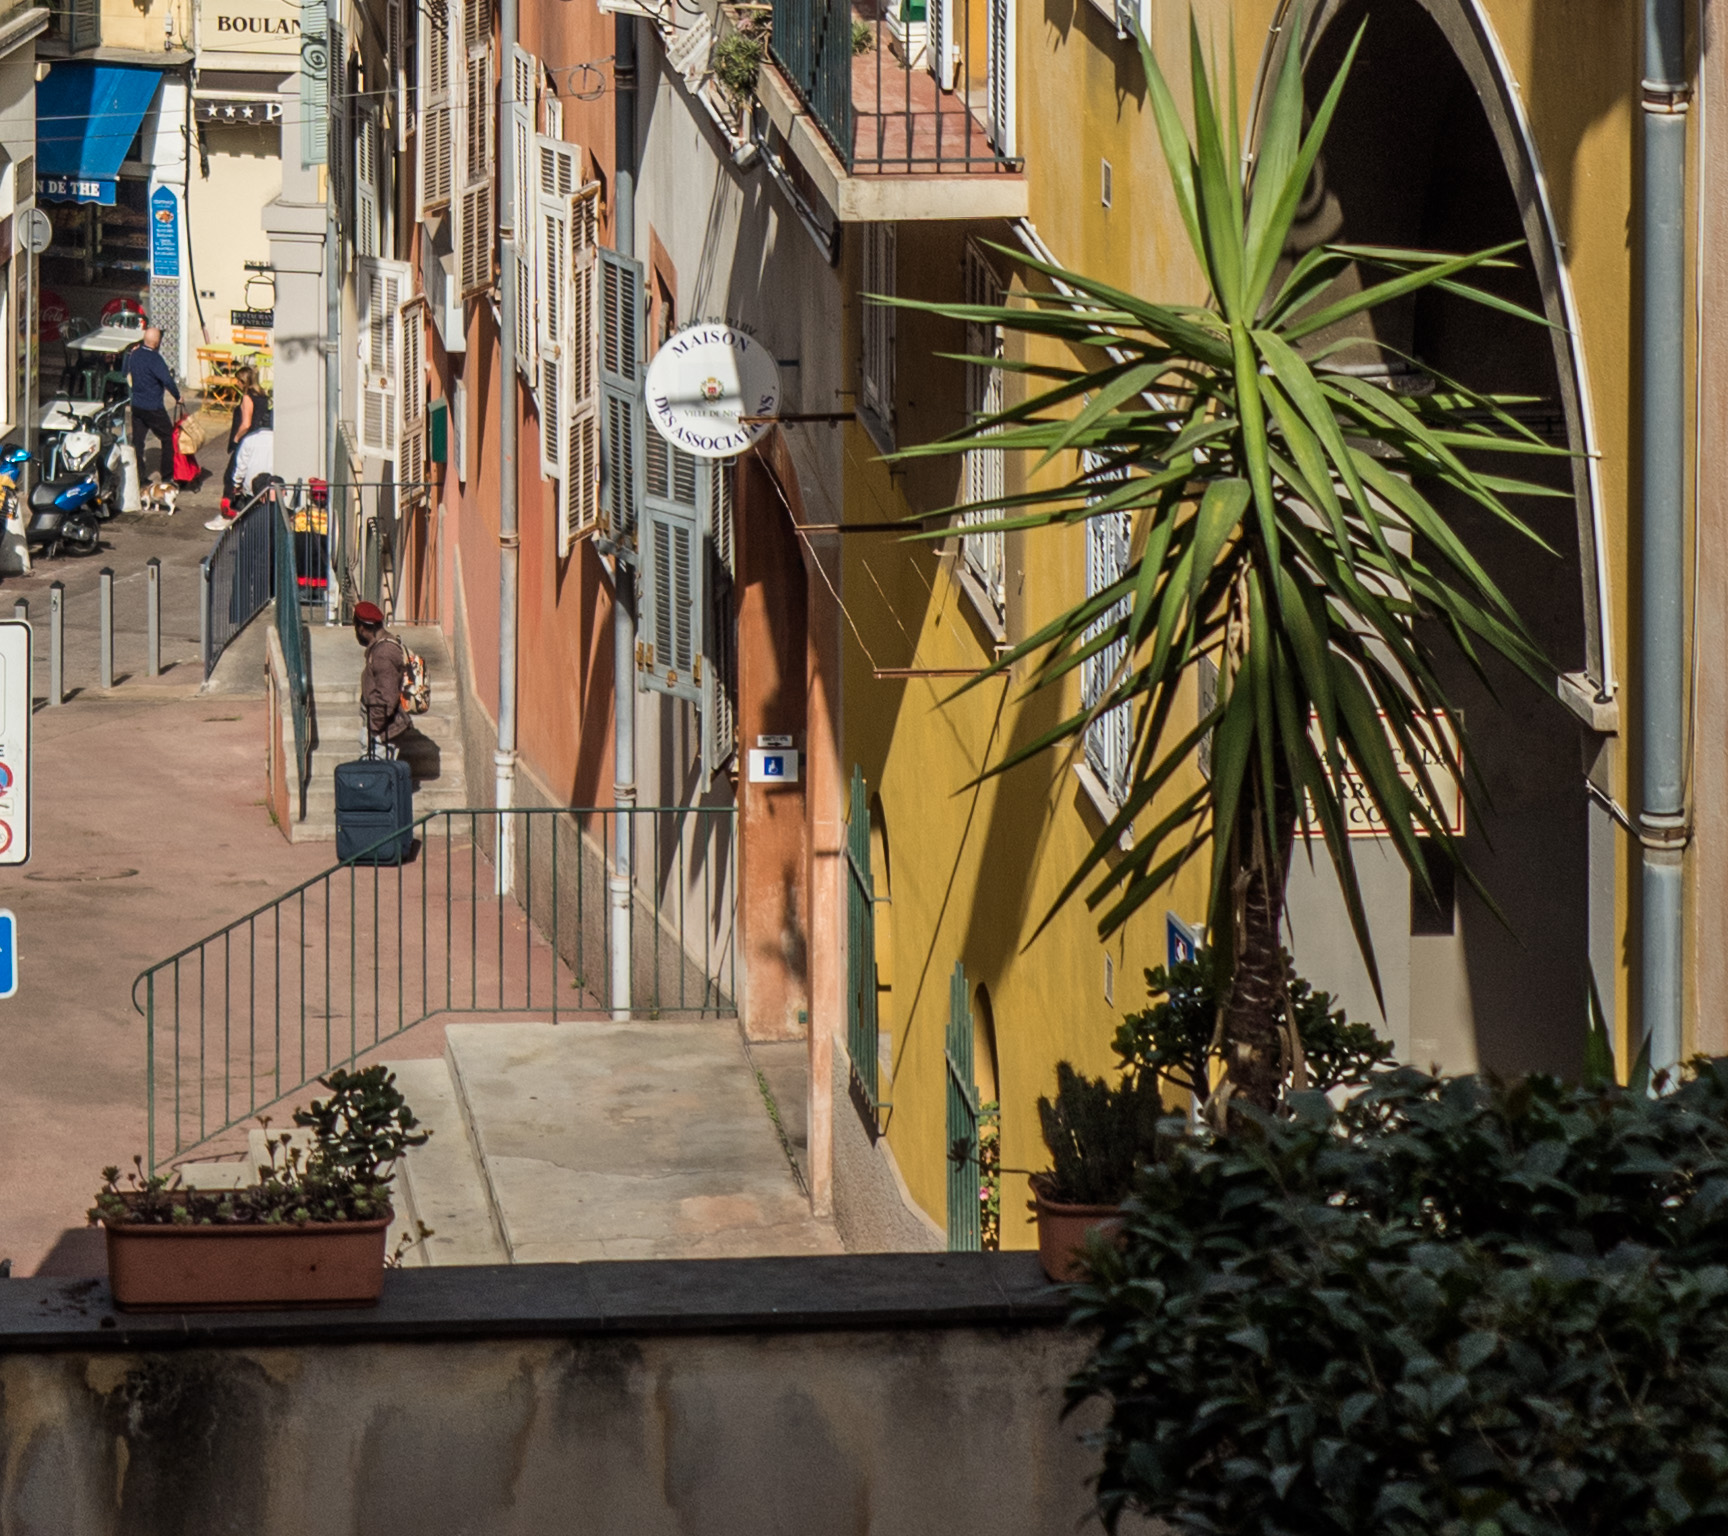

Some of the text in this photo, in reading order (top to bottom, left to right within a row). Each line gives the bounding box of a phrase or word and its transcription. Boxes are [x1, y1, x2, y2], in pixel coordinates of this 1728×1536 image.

[48, 180, 67, 195] DE
[70, 181, 100, 197] THE
[671, 330, 751, 358] MAISON
[654, 396, 677, 427] DES
